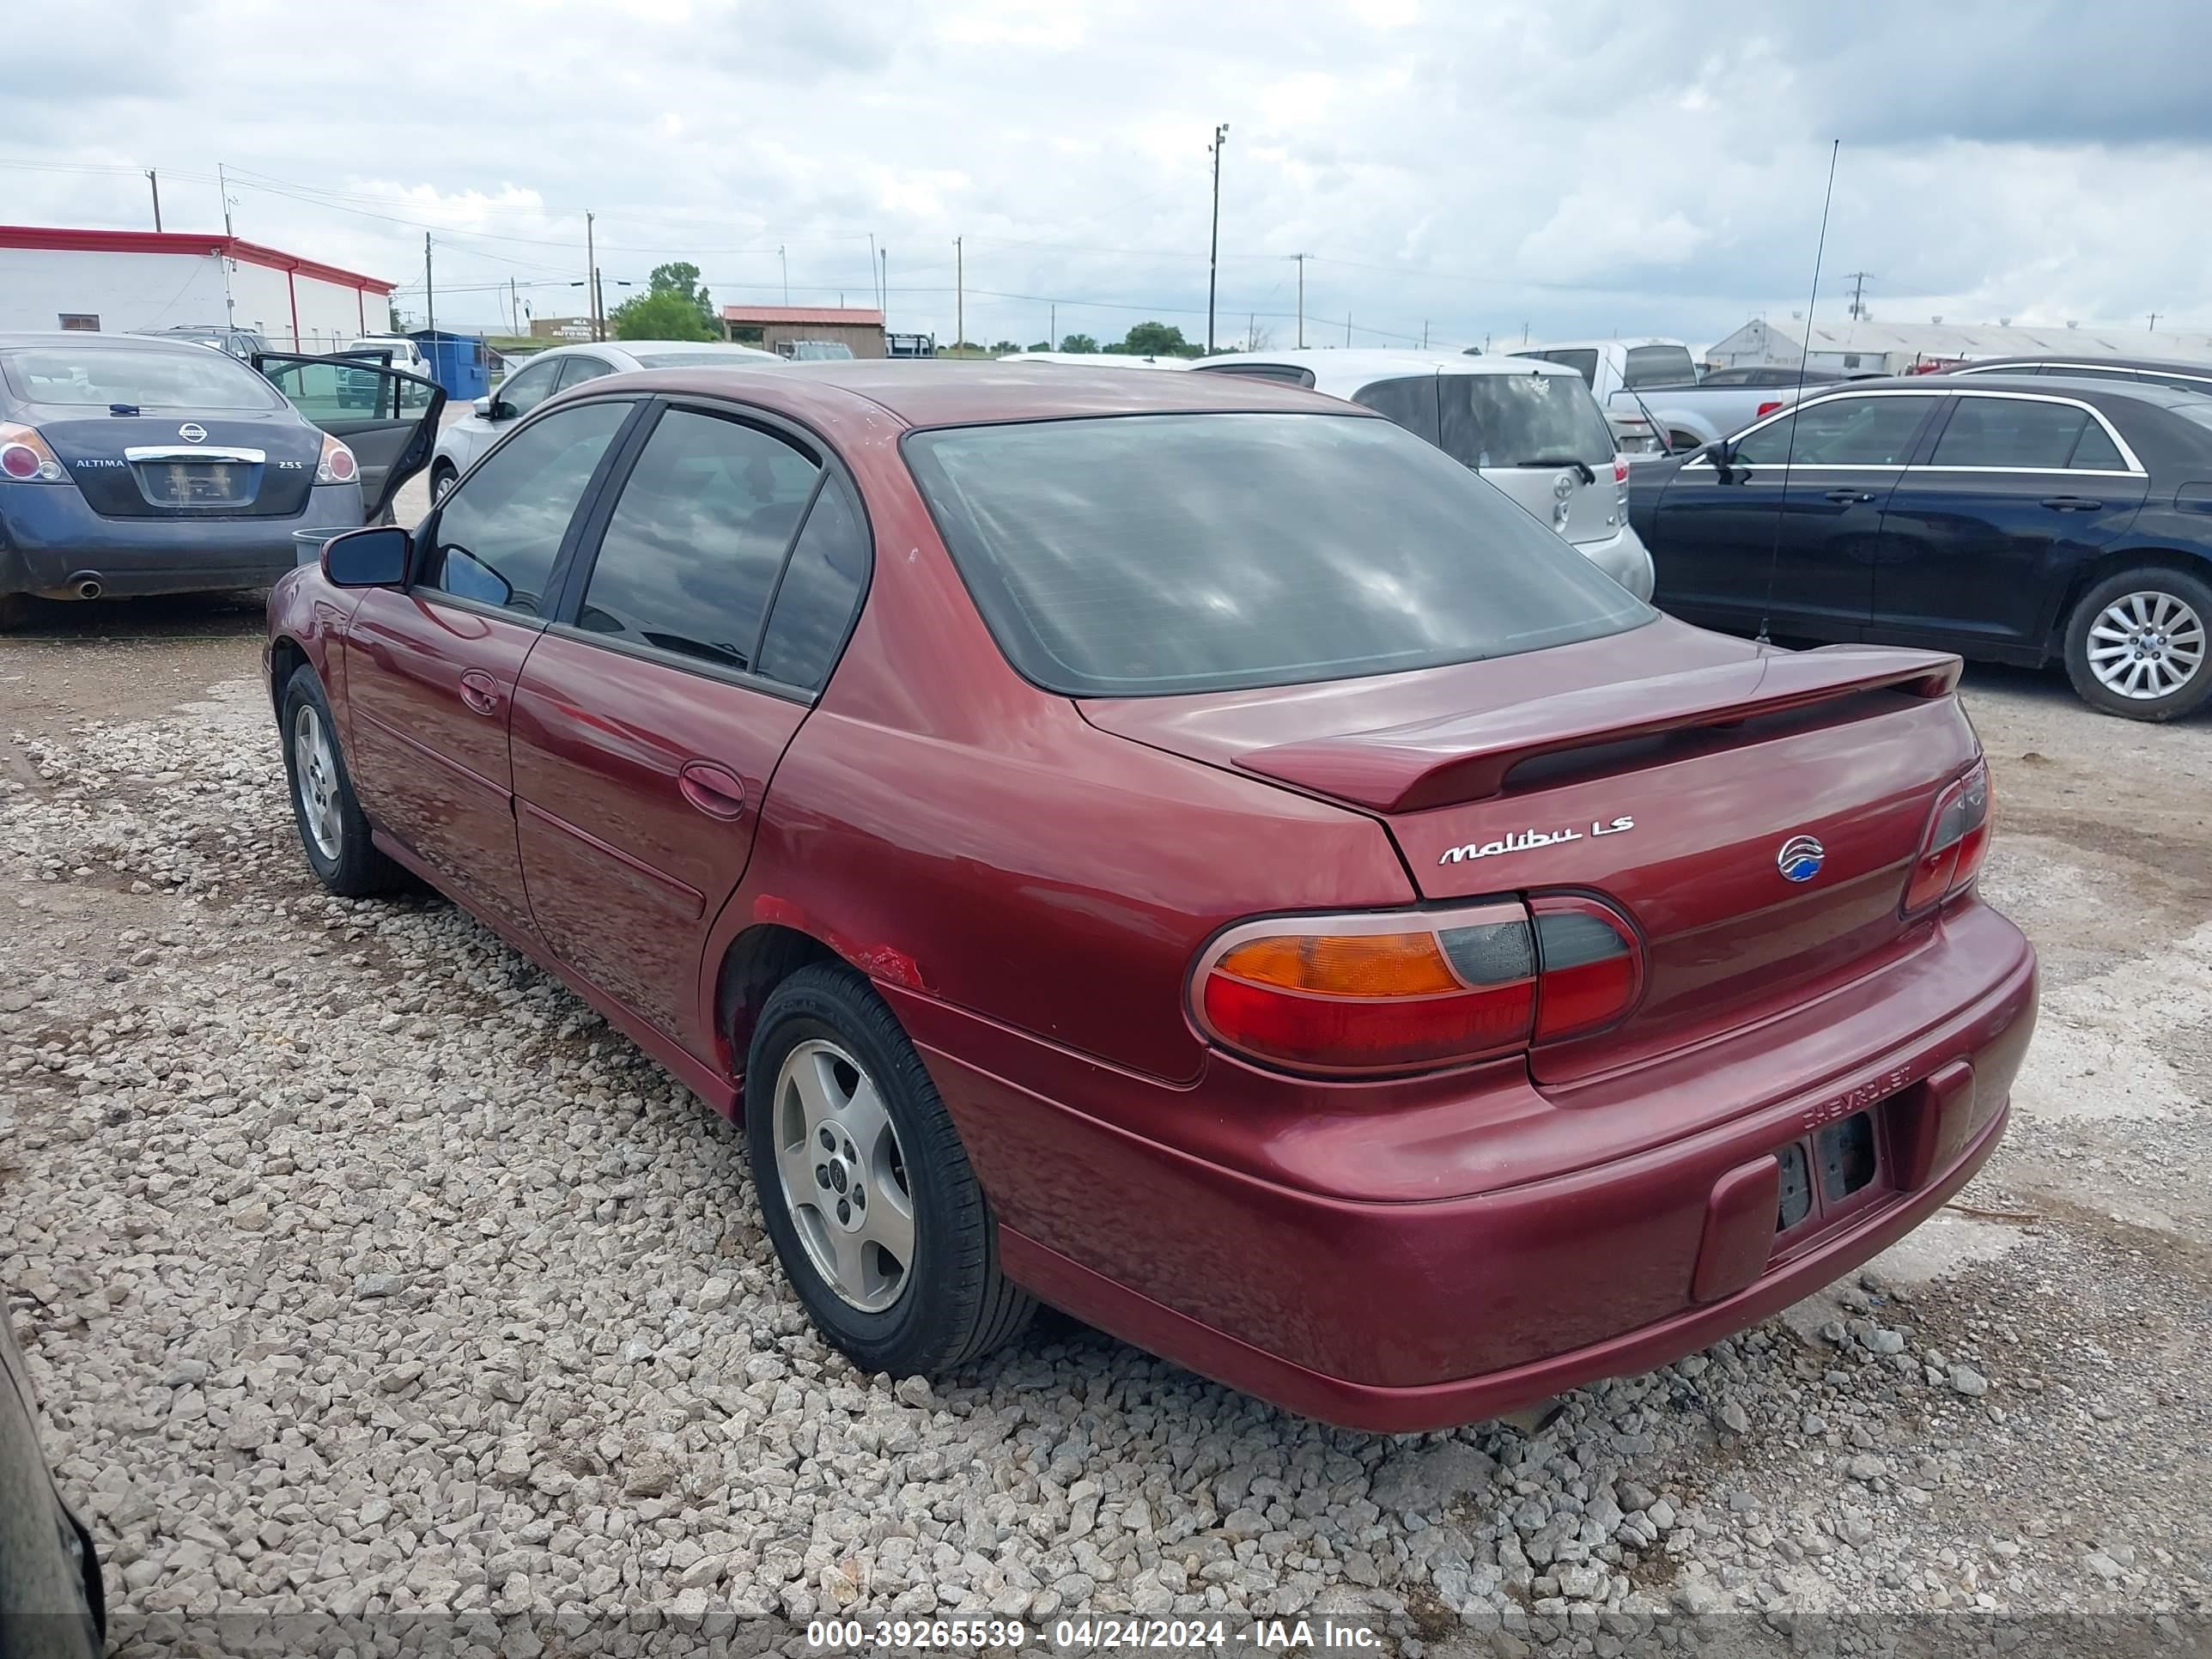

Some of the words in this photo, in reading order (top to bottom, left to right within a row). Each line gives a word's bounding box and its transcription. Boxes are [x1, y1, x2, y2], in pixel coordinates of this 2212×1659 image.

[76, 459, 126, 469] ALTIMA
[1438, 829, 1583, 866] Malibu
[1591, 816, 1635, 836] LS
[1802, 1065, 1911, 1129] CHEVROLET
